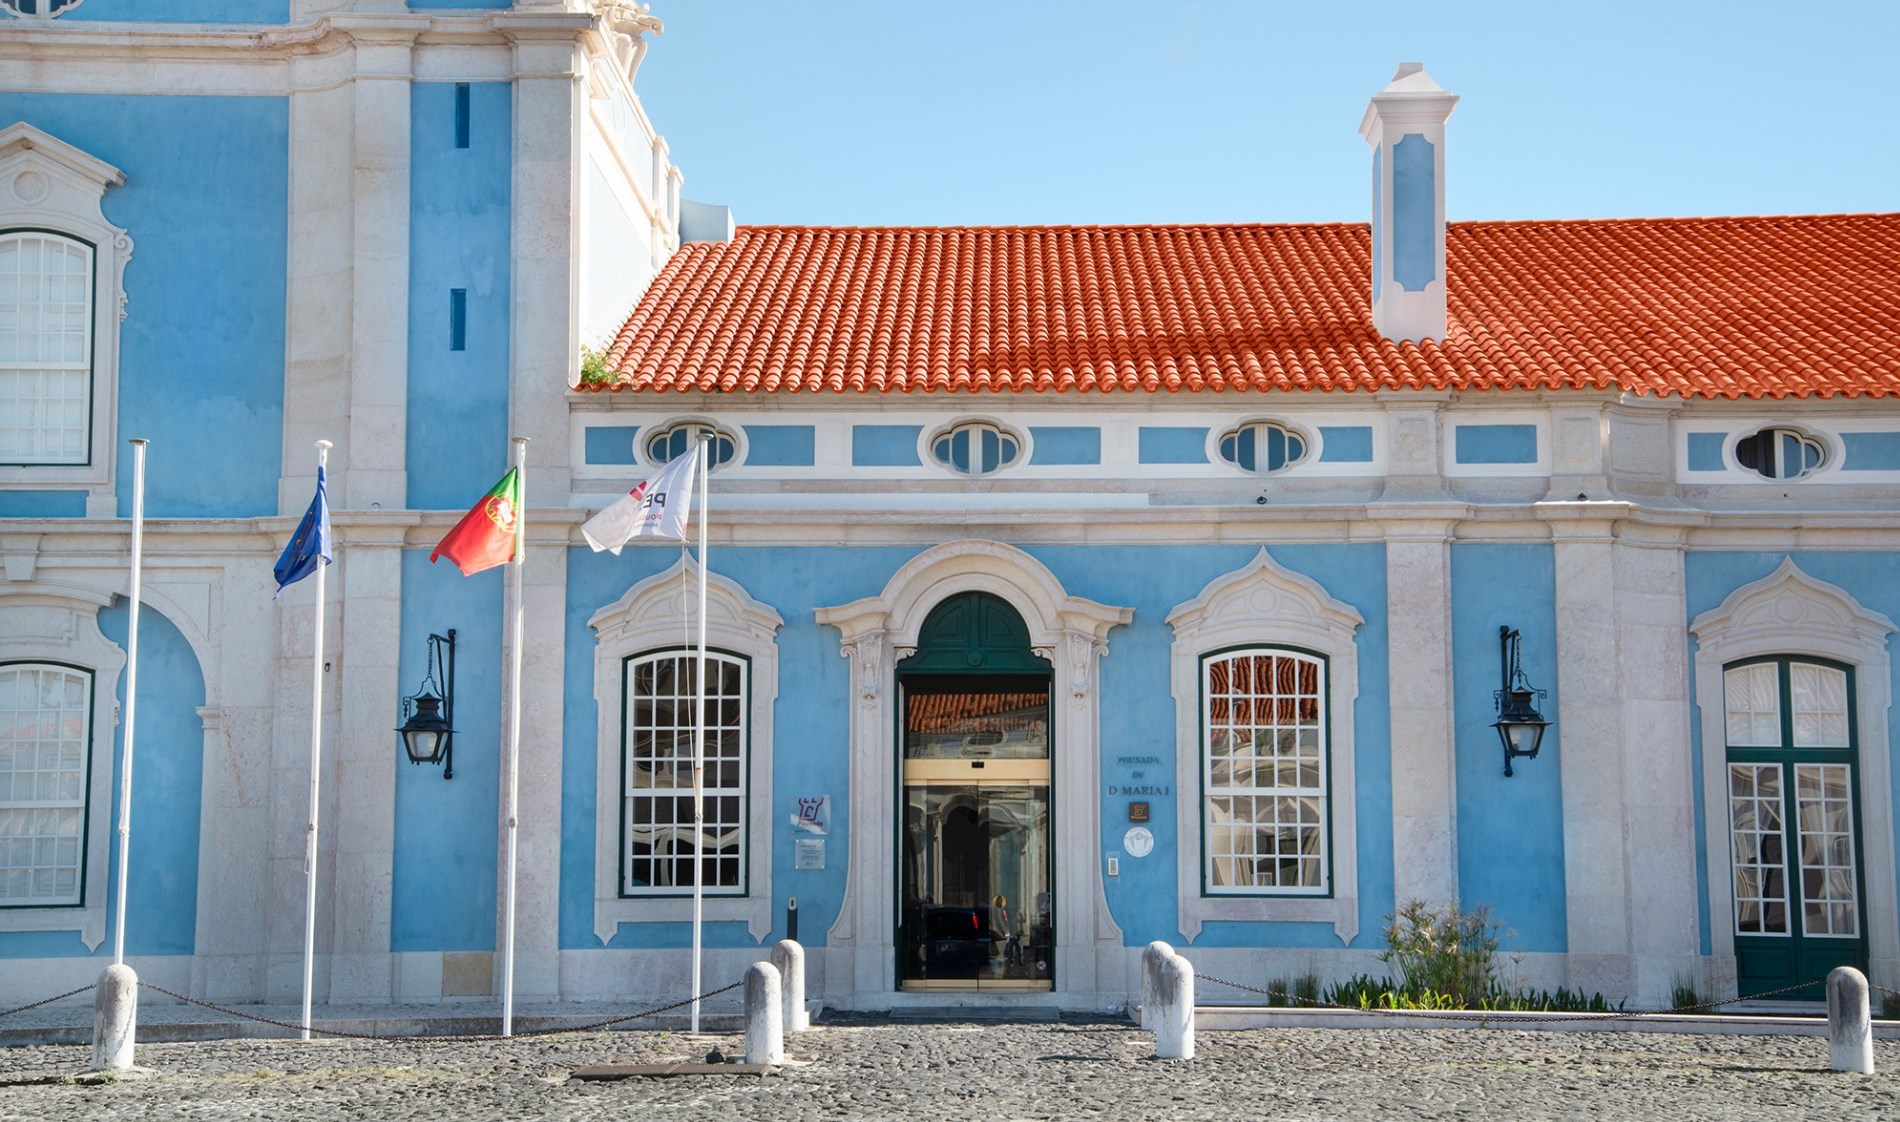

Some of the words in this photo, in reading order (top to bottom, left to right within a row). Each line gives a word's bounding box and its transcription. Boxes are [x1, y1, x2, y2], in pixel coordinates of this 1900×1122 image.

[1133, 771, 1143, 779] DE
[1109, 786, 1117, 795] D
[1122, 786, 1162, 795] MARIA
[1165, 786, 1169, 795] I
